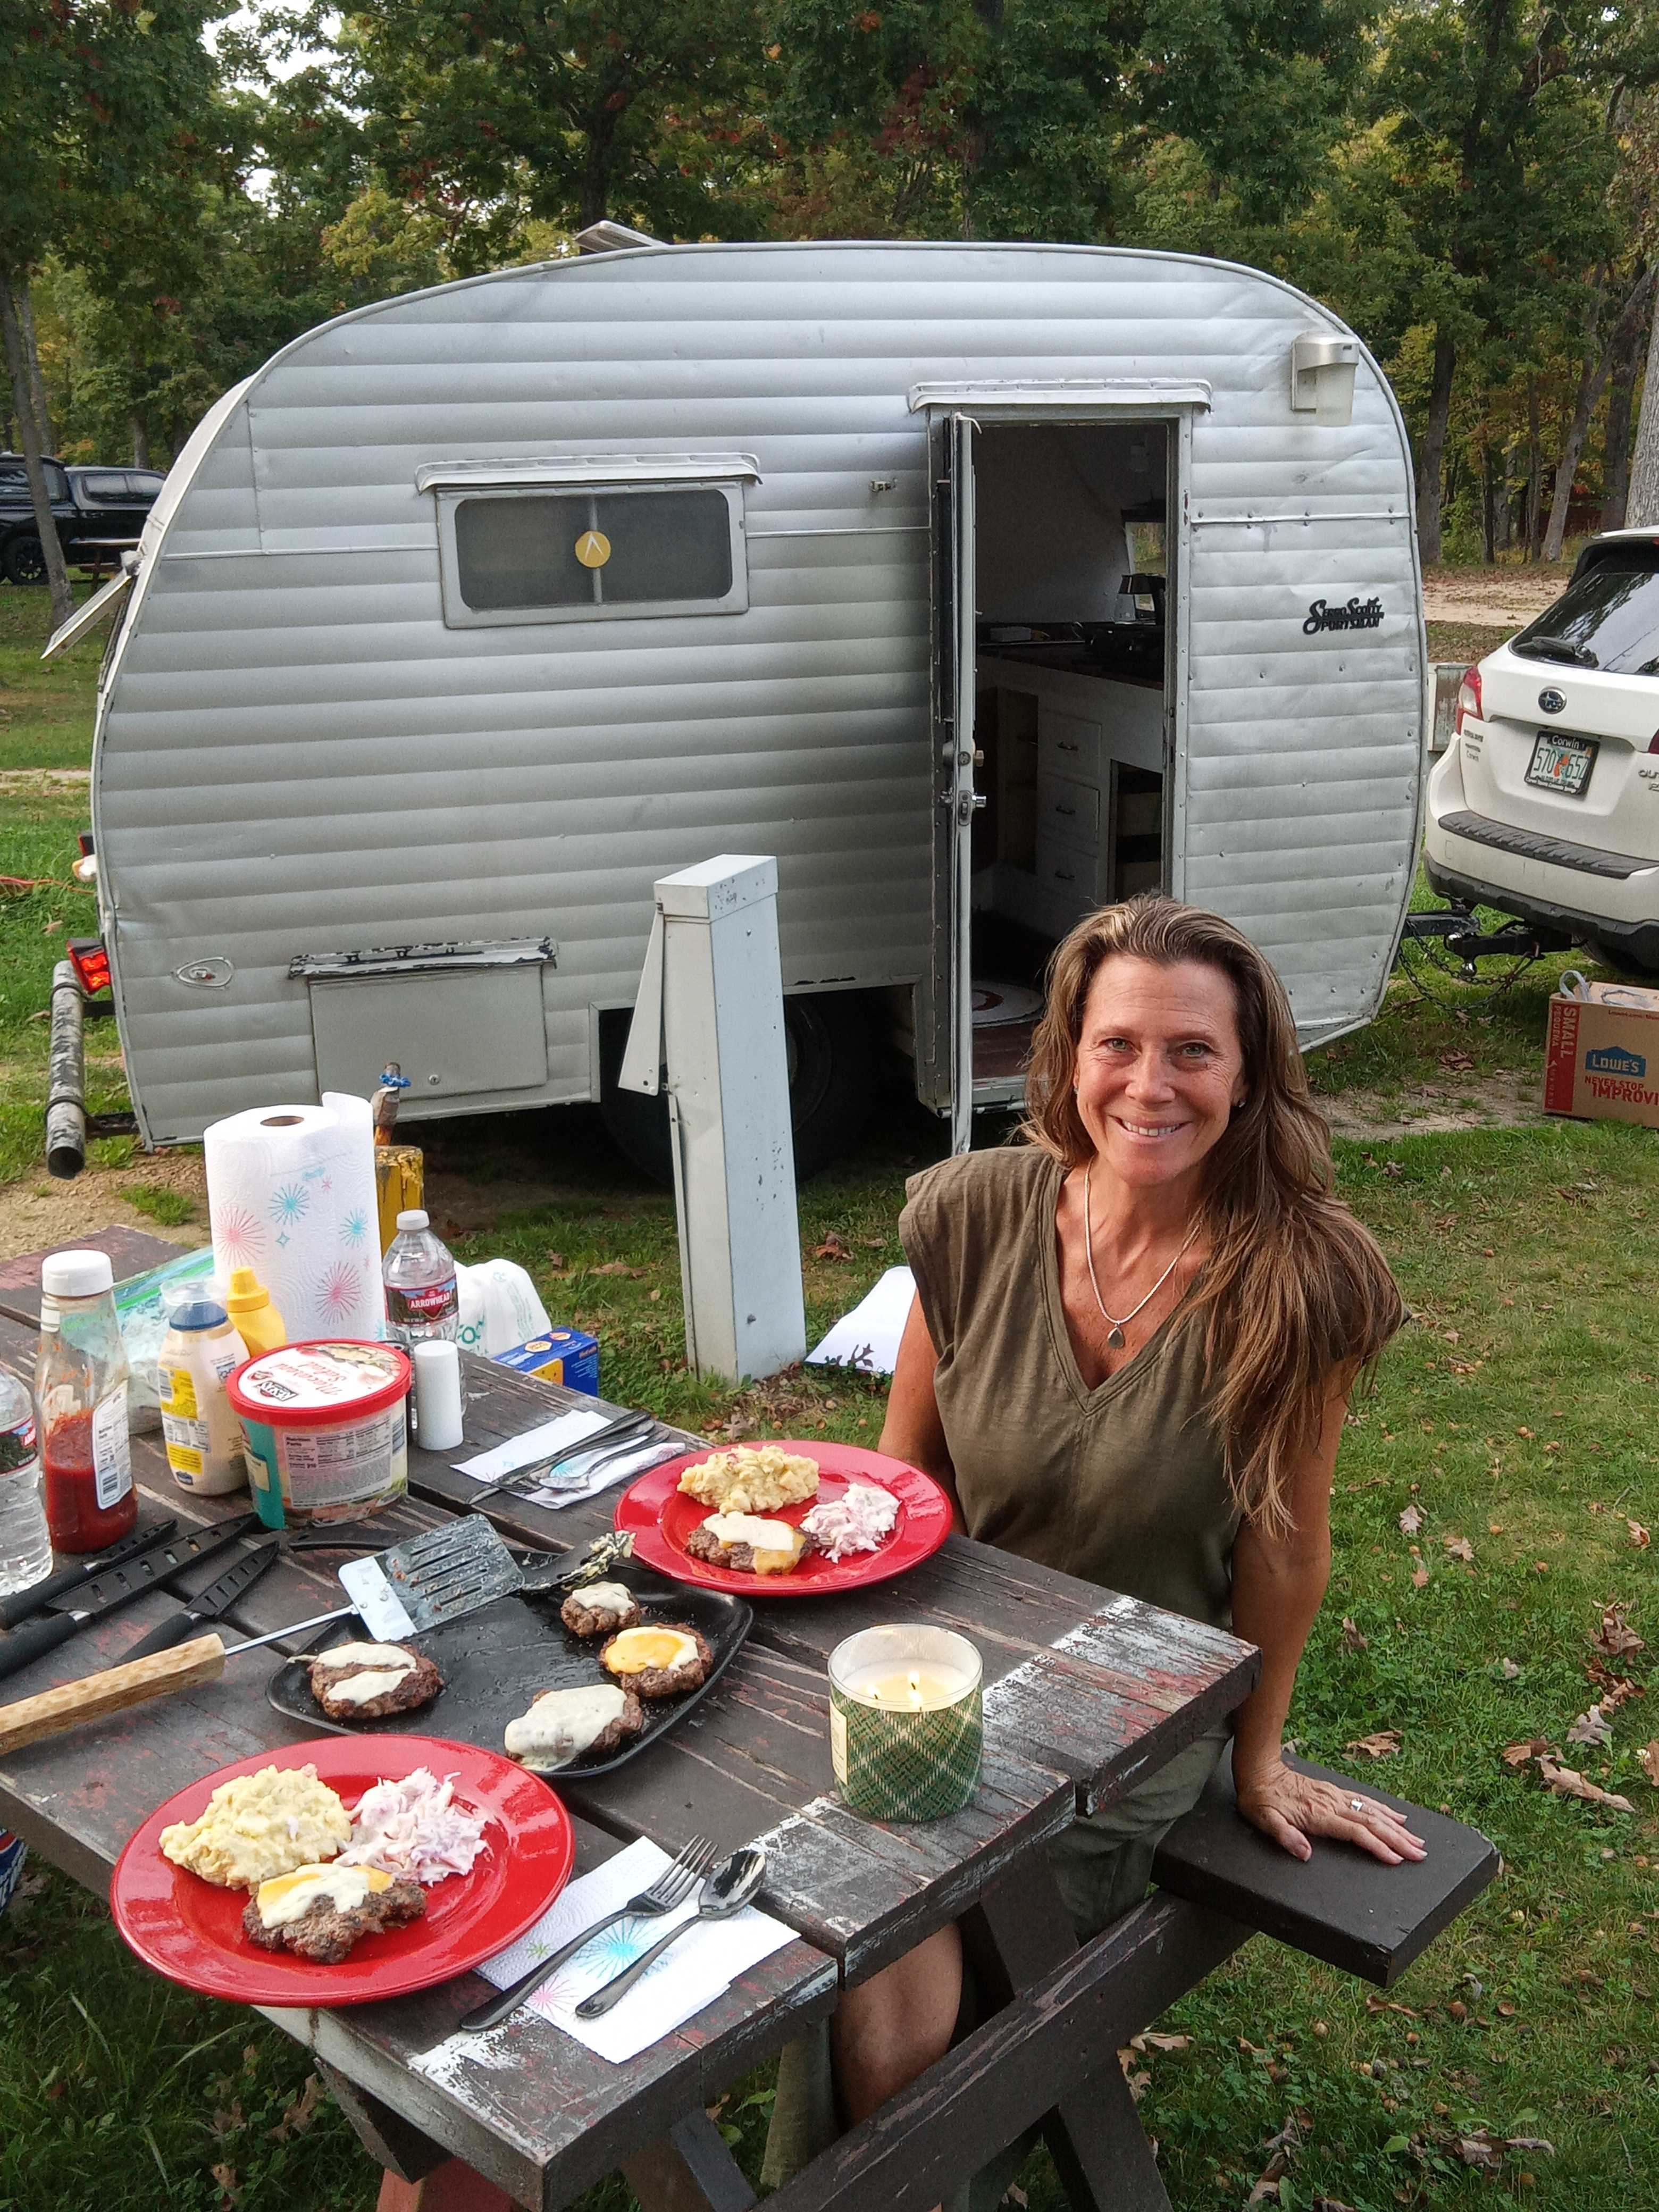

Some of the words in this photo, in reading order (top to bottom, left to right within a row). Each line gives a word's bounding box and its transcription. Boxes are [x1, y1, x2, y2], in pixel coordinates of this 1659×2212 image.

[1552, 735, 1579, 749] Corwin
[1534, 748, 1556, 774] 570
[1560, 1007, 1577, 1059] SMALL
[1585, 1076, 1617, 1088] NEVER
[1618, 1082, 1644, 1090] STOP
[410, 1292, 450, 1309] ARROWHEAD
